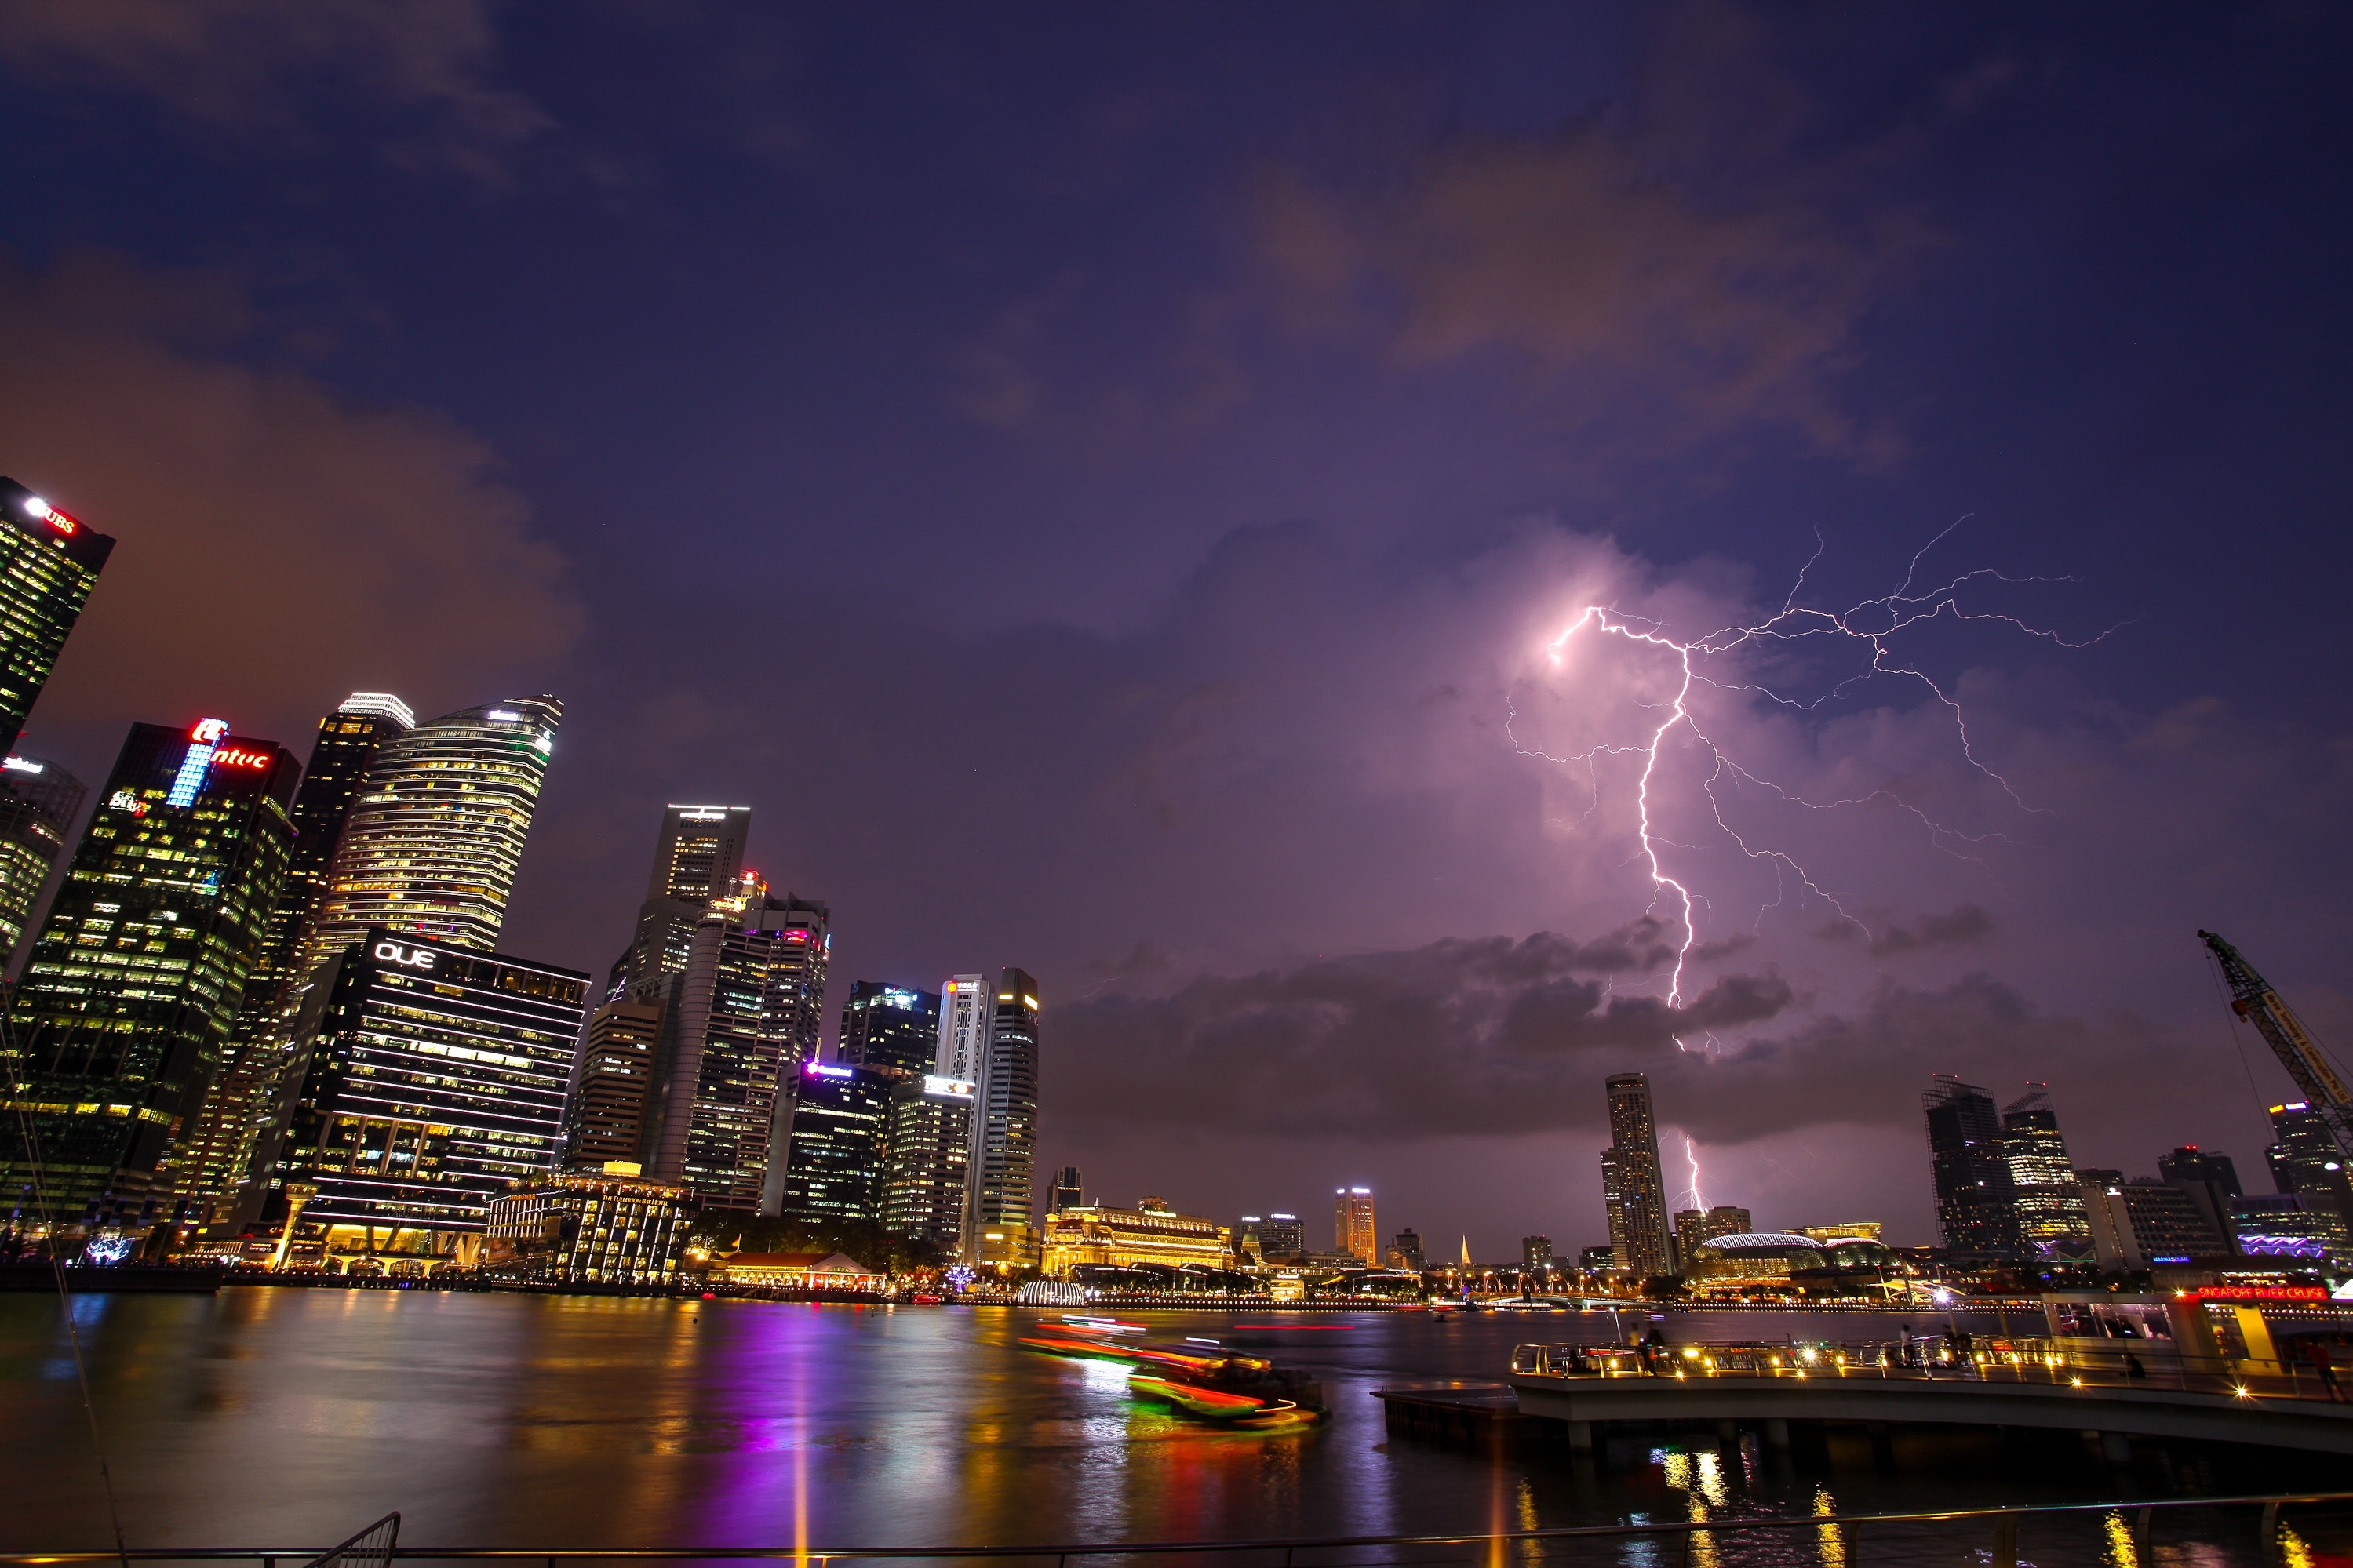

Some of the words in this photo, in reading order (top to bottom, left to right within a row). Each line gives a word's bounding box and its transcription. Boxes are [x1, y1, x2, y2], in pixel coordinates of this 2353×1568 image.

[45, 507, 75, 533] UBS
[374, 943, 437, 969] OUE
[2267, 994, 2281, 1011] Marine
[2280, 1011, 2302, 1040] Technology
[2305, 1046, 2331, 1080] Construction
[613, 1195, 642, 1204] FULLERTON
[2198, 1287, 2253, 1298] SINGAPORE
[2254, 1288, 2286, 1298] RIVER
[2286, 1288, 2326, 1299] CRUISE
